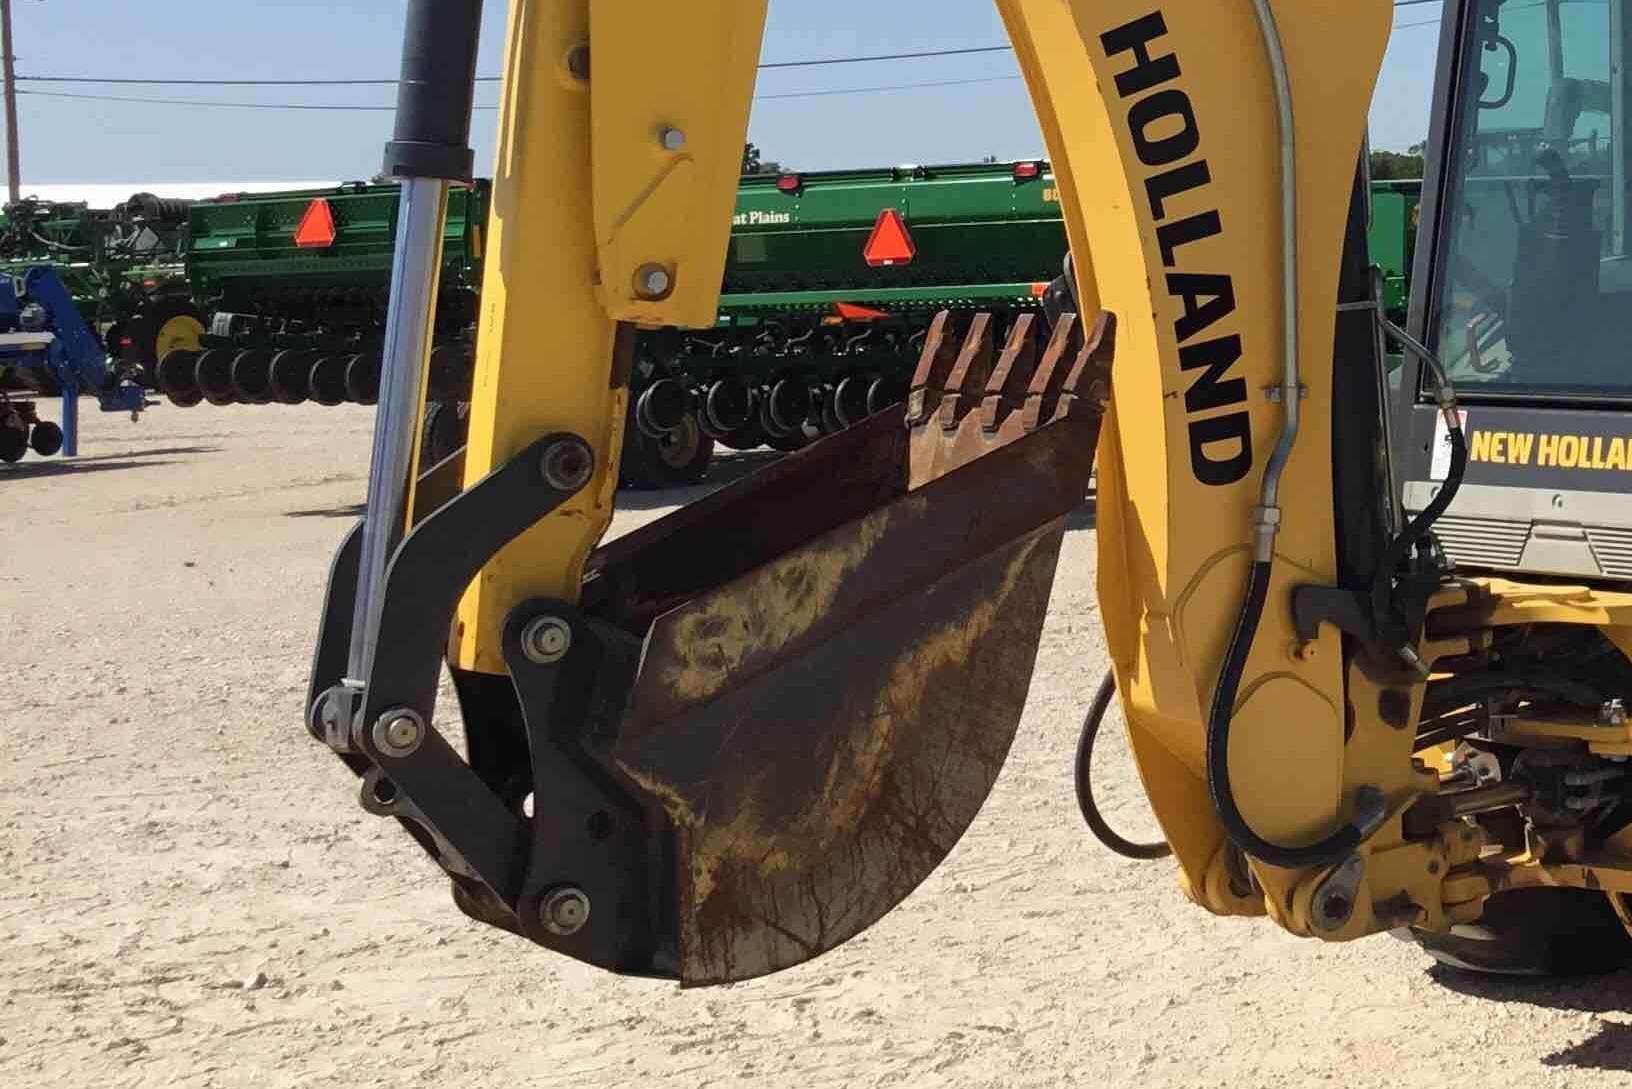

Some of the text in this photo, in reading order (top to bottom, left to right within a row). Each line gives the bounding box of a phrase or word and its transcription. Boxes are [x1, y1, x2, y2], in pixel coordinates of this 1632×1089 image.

[749, 210, 790, 224] Plains
[1099, 9, 1253, 487] HOLLAND
[1469, 430, 1534, 465] NEW
